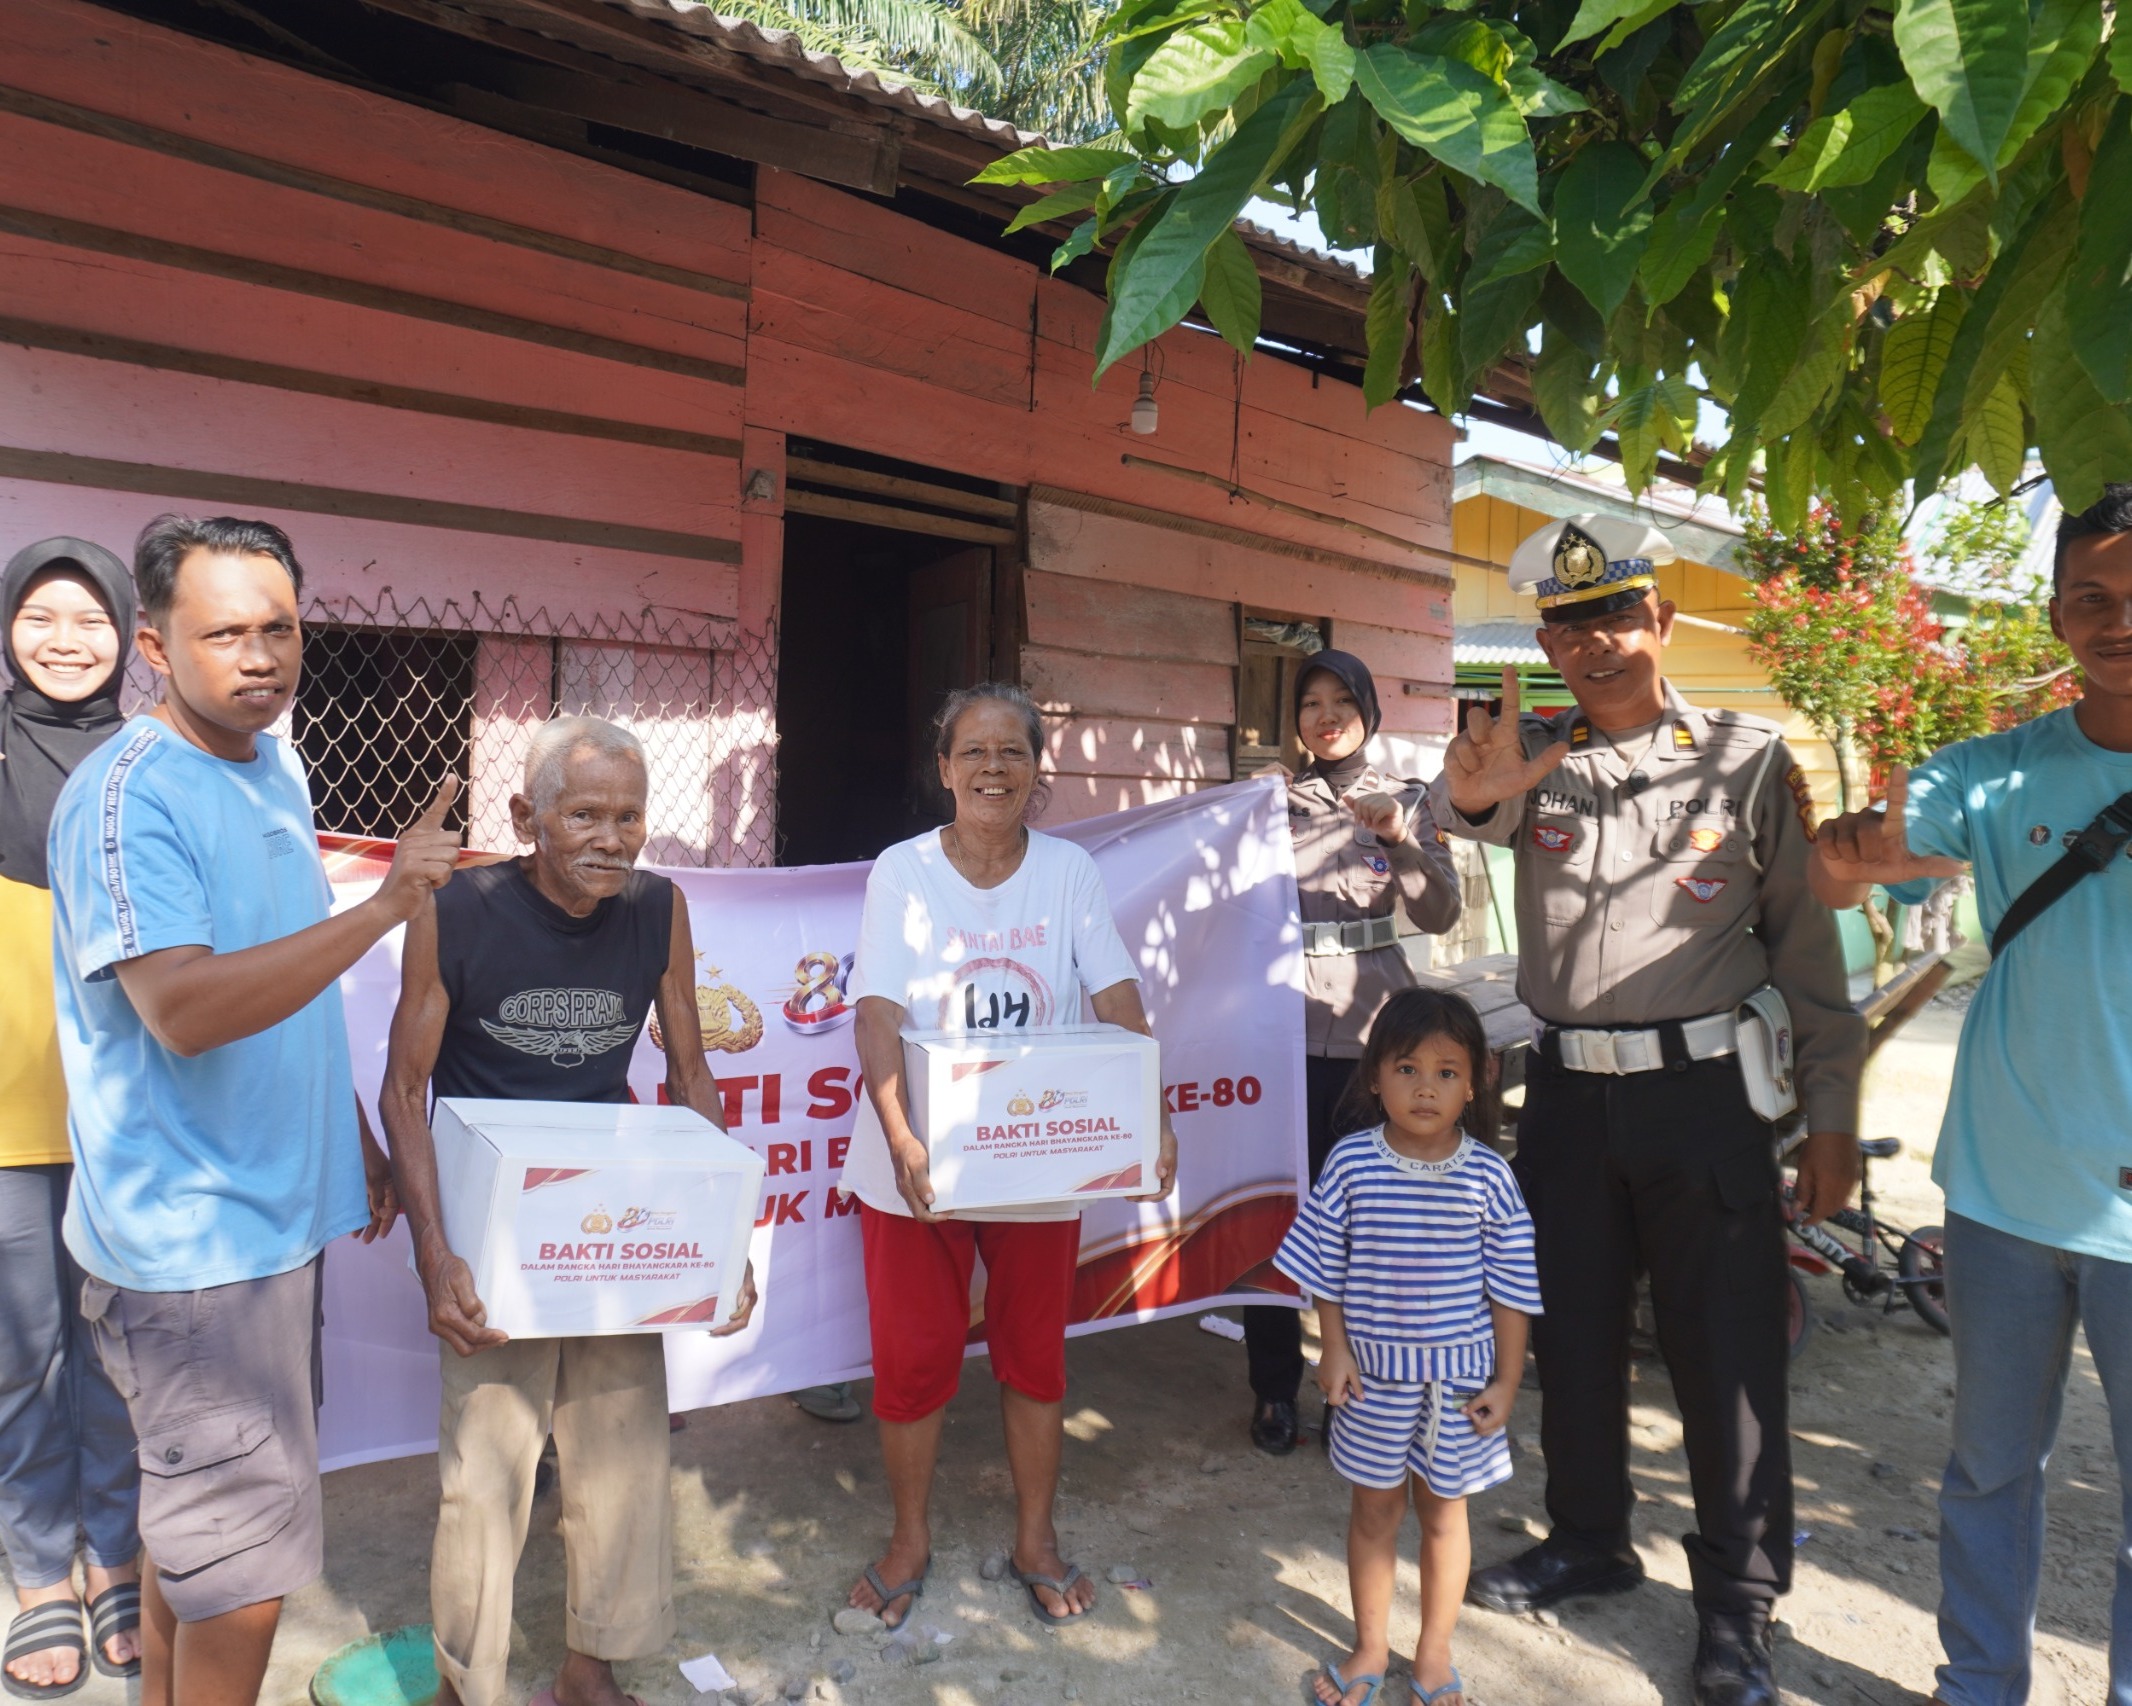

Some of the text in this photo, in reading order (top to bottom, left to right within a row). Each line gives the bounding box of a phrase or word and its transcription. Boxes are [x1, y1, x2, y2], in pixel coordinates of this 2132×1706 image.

[1531, 788, 1594, 817] JOHAN
[1669, 797, 1743, 818] POLRI
[946, 924, 1047, 953] SANTAI BAE
[976, 1116, 1120, 1142] BAKTI SOSIAL
[963, 1132, 1133, 1152] DALAM RANGKA HARI BHAYANGKARA KE-80
[993, 1144, 1104, 1159] POLRI UNTUK MASYARAKAT
[1376, 1140, 1466, 1172] SEPT CARATS
[538, 1242, 704, 1261] BAKTI SOSIAL
[520, 1260, 715, 1271] DALAM RANGKA HARI BHAYANGKARA KE-80
[585, 1274, 618, 1282] UNTUK
[619, 1273, 681, 1281] MASYARAKAT
